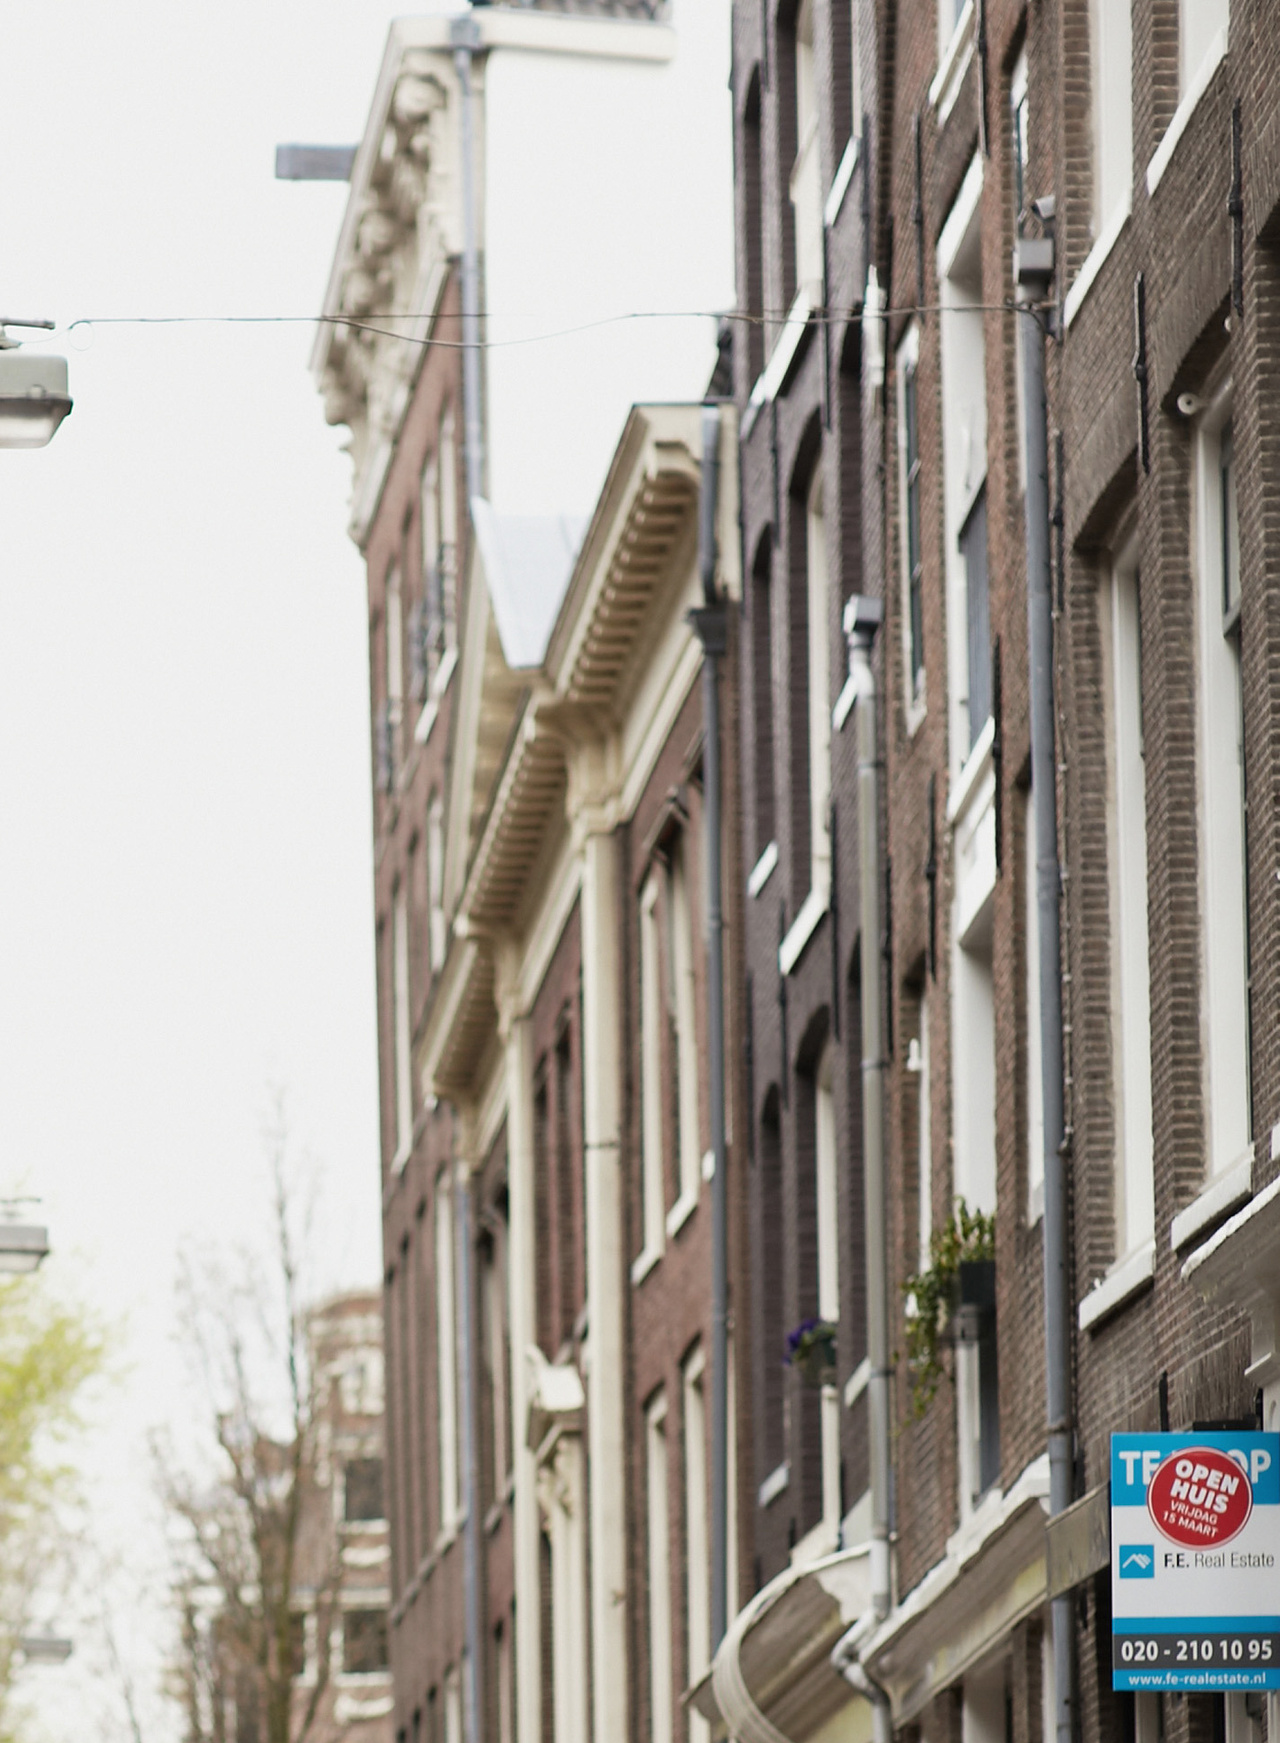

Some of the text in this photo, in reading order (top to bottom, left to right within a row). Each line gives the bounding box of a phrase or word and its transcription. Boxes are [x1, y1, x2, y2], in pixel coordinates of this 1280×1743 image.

[1175, 1459, 1239, 1496] OPEN
[1170, 1478, 1229, 1514] HUIS
[1171, 1499, 1218, 1525] VRIJDAG
[1178, 1515, 1218, 1538] MAART
[1164, 1552, 1275, 1568] F.E. Real Estate
[1121, 1641, 1159, 1661] 020
[1176, 1640, 1213, 1661] 210
[1219, 1640, 1243, 1661] 10
[1248, 1639, 1273, 1661] 95
[1128, 1672, 1267, 1686] www.fe-realestate.nl
